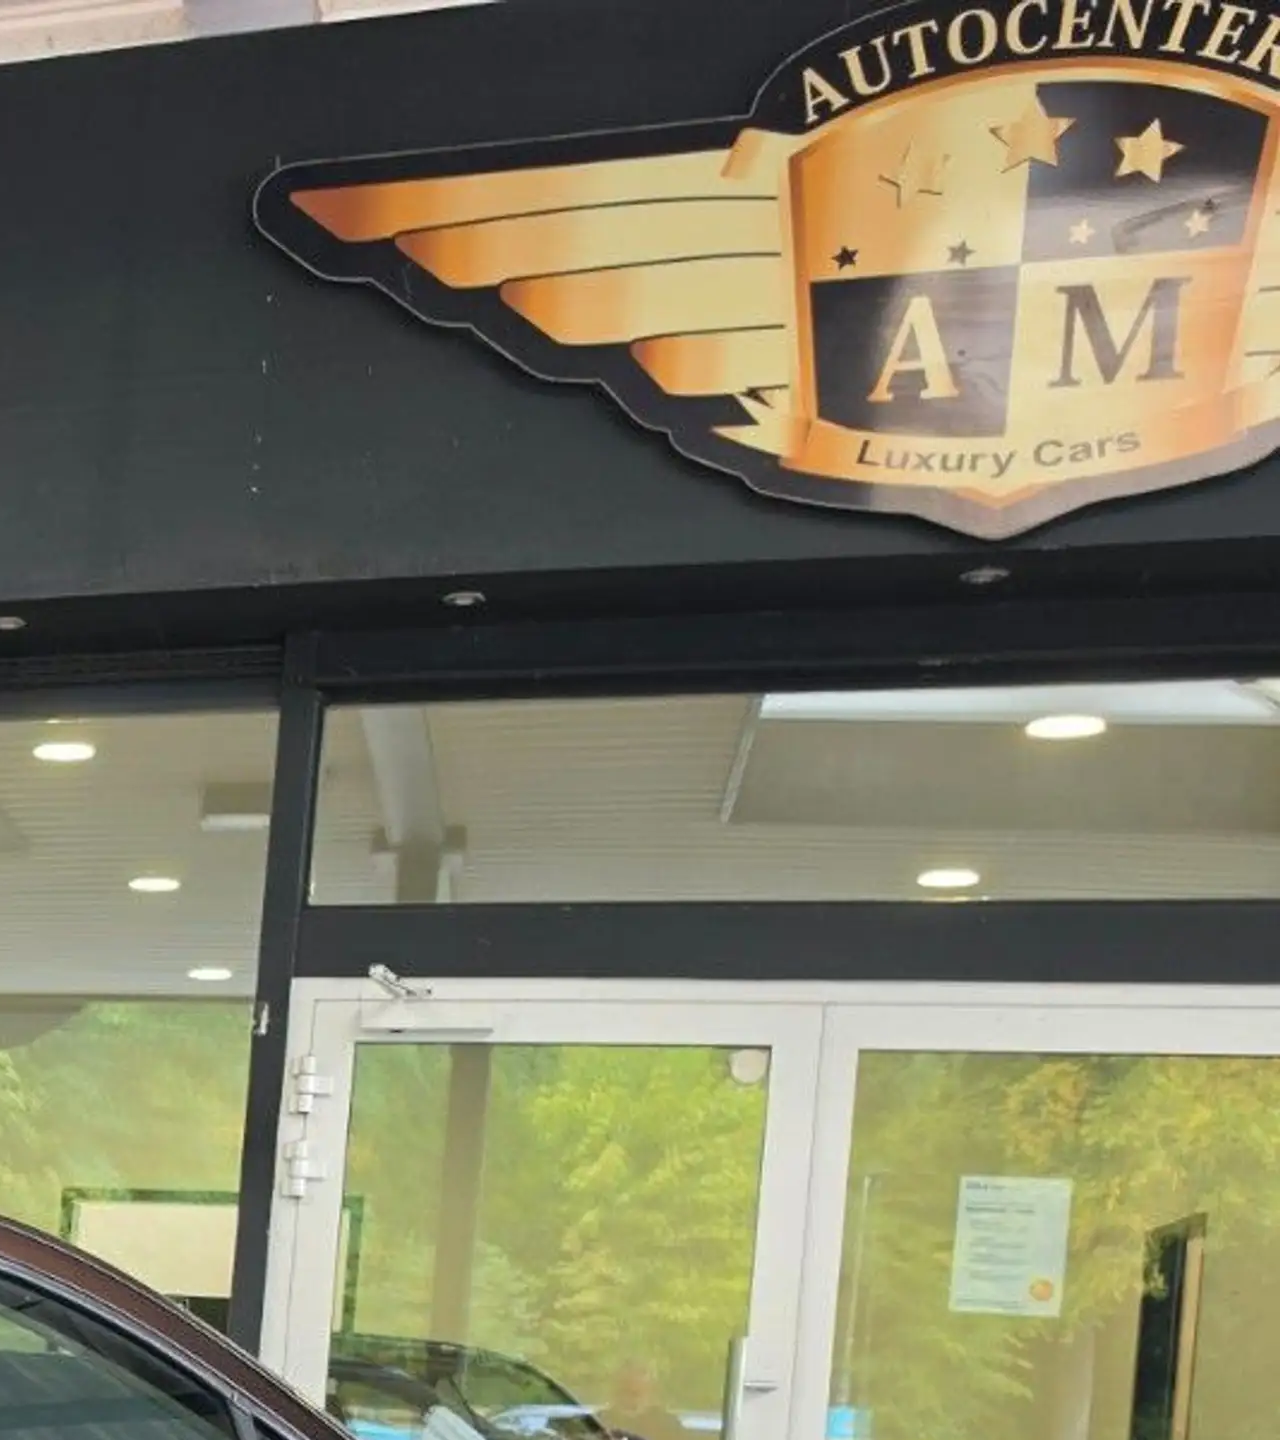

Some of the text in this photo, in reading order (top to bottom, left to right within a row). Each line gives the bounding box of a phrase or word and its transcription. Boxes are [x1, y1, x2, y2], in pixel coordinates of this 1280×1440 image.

[866, 276, 1194, 403] A M
[855, 430, 1141, 479] Luxury Cars
